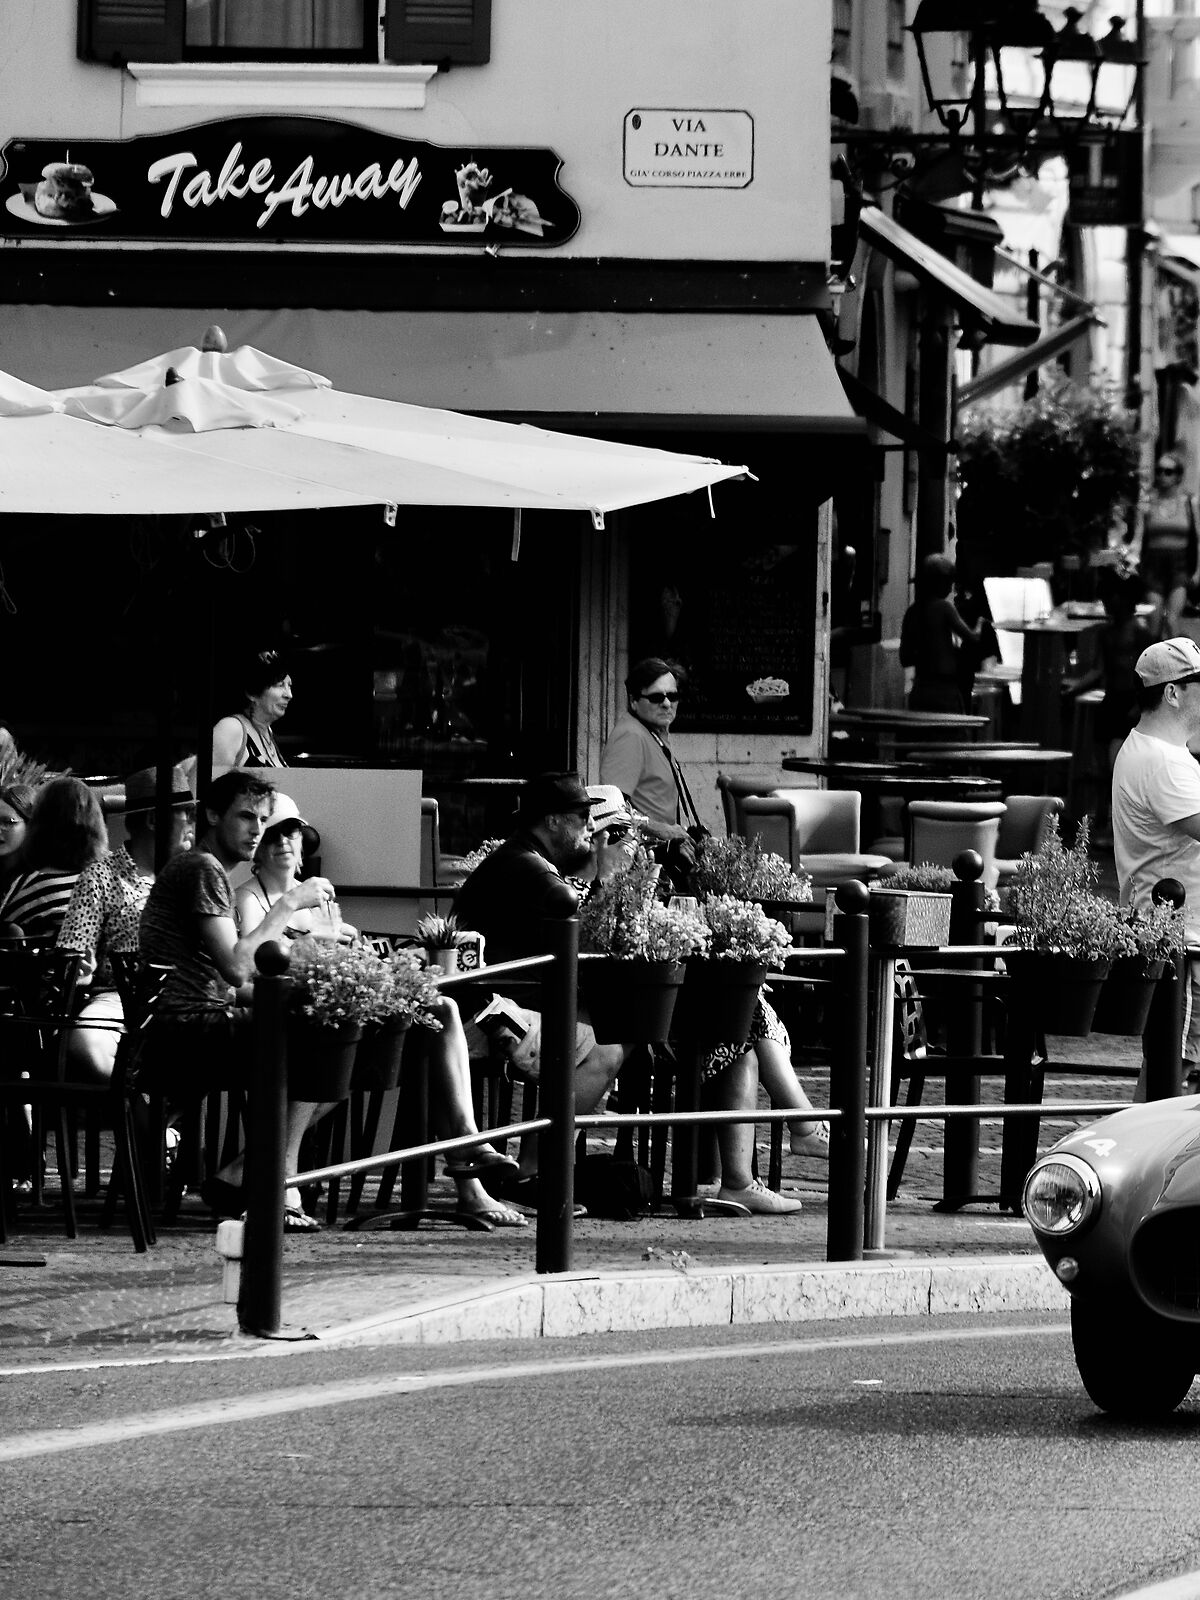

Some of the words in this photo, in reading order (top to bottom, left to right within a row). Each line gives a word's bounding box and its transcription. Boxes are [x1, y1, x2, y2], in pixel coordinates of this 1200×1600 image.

[672, 118, 706, 132] VIA
[654, 142, 724, 157] DANTE
[652, 170, 685, 178] CORSO
[147, 142, 274, 218] Take
[257, 155, 422, 228] Away
